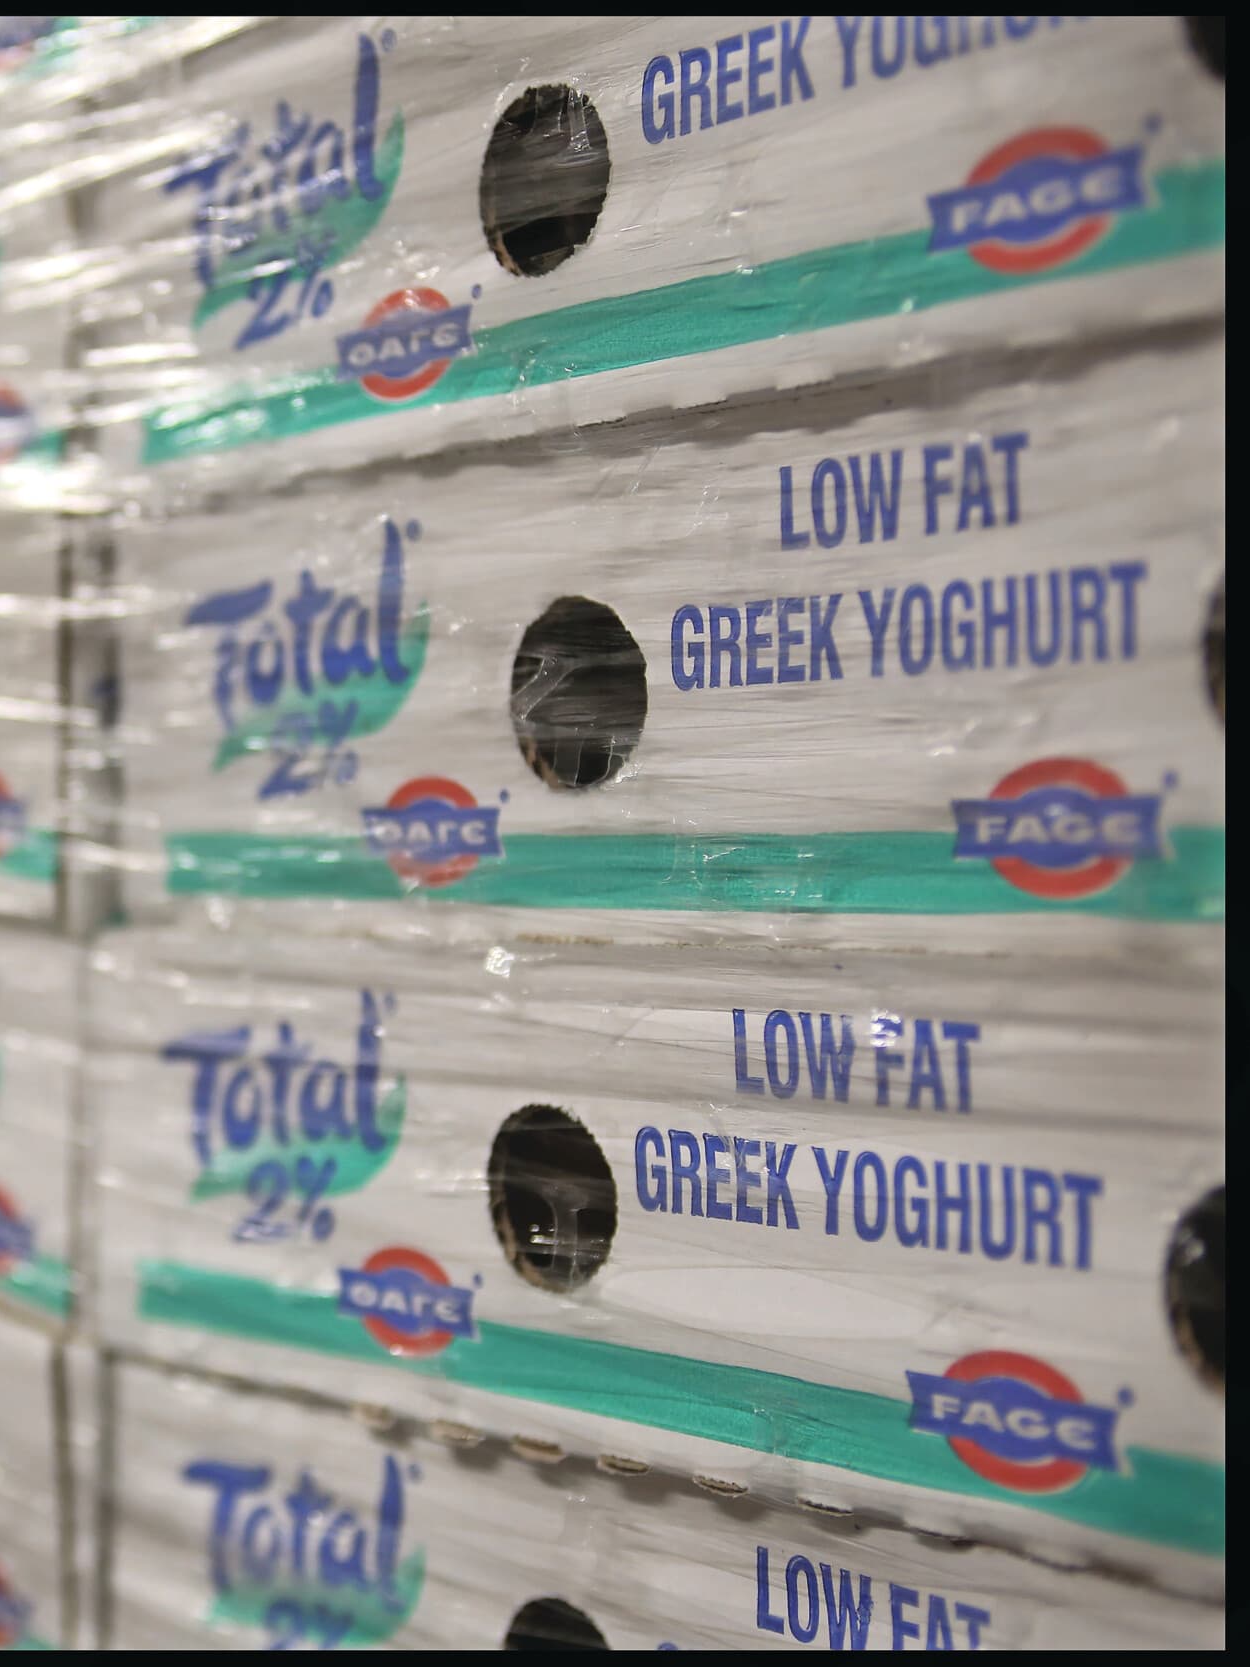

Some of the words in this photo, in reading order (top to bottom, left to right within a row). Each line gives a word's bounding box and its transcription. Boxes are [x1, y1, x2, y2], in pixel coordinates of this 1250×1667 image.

[641, 16, 814, 145] GREEK
[780, 450, 904, 551] LOW
[923, 431, 1030, 536] FAT
[184, 518, 410, 736] Total
[671, 593, 844, 692] GREEK
[858, 560, 1148, 678] YOGHURT
[161, 988, 388, 1168] Total
[733, 1008, 855, 1102] LOW
[870, 1015, 981, 1115] FAT
[635, 1126, 800, 1230] GREEK
[811, 1145, 1104, 1272] YOGHURT
[931, 1395, 1098, 1452] FAGE
[180, 1454, 408, 1616] Total
[756, 1546, 873, 1650] LOW
[890, 1582, 992, 1650] FAT
